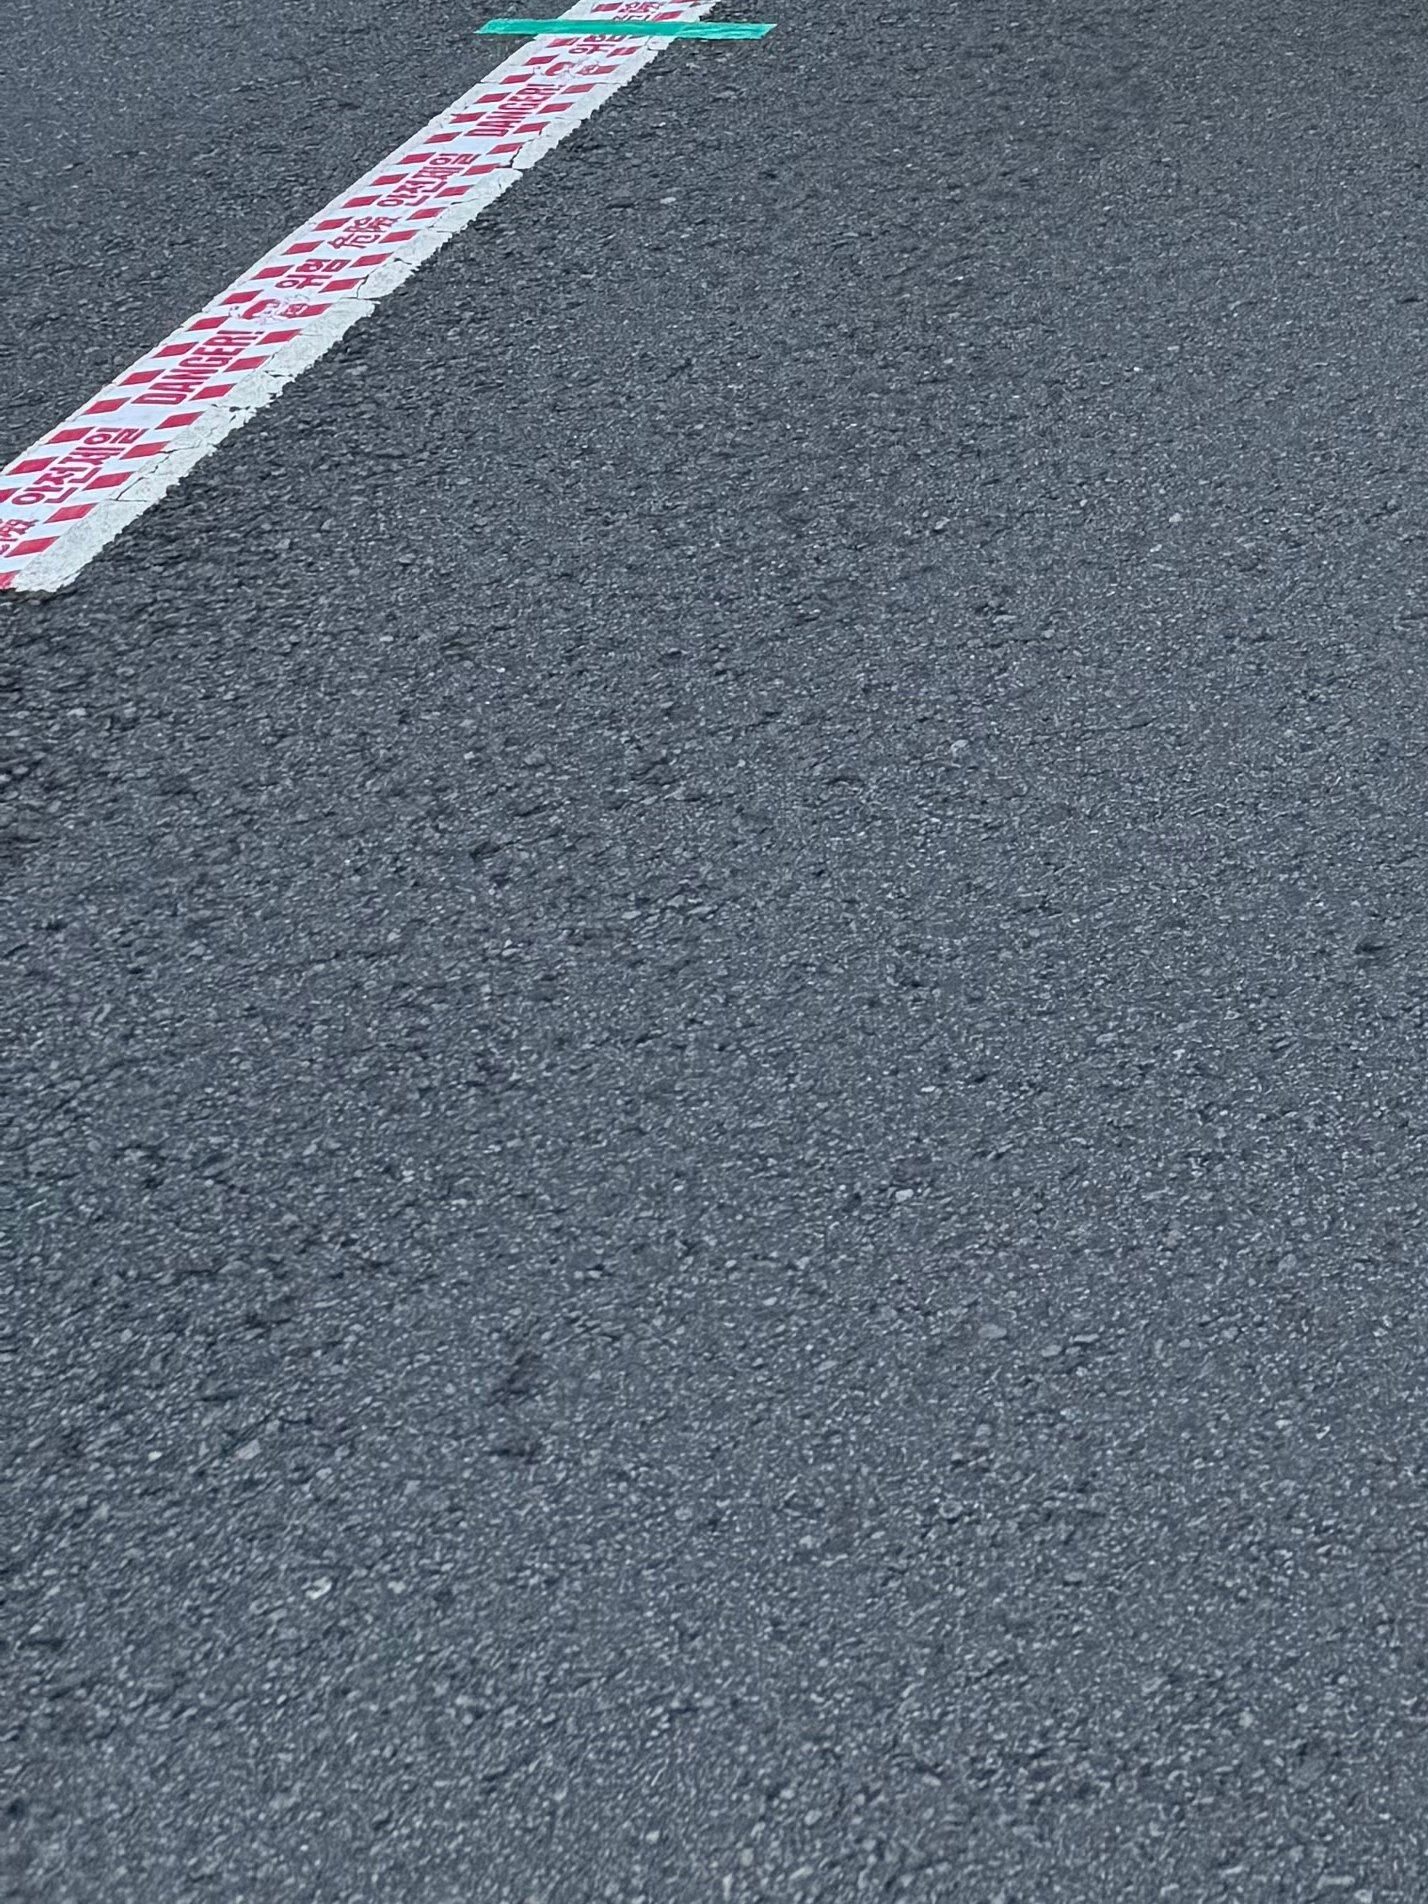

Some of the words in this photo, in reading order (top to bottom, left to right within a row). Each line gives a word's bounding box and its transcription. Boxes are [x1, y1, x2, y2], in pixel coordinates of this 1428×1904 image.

[463, 82, 567, 139] DANGER!
[376, 150, 483, 210] 안전제일
[274, 257, 350, 292] 위험
[131, 328, 268, 407] DANGER!
[12, 424, 145, 508] 안전제일
